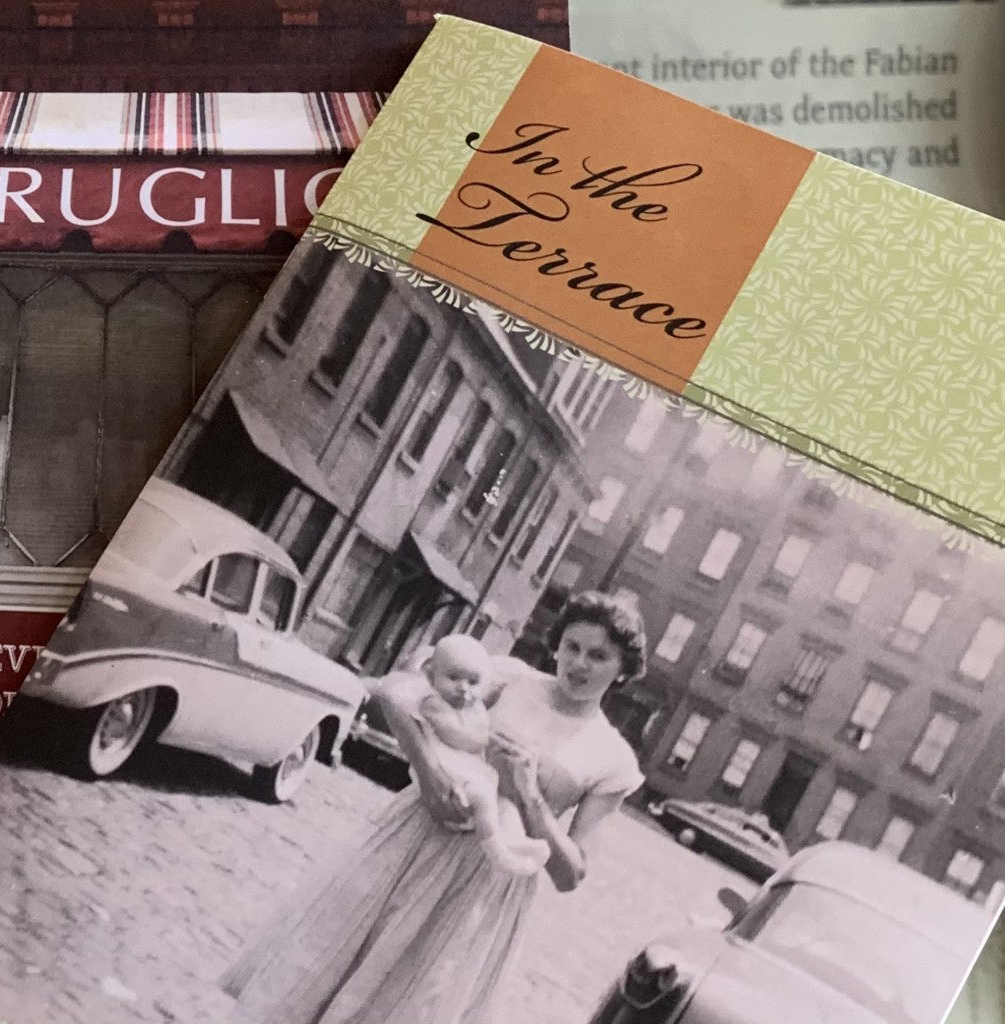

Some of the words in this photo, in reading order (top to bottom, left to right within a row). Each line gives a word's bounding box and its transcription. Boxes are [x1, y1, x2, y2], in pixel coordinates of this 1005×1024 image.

[652, 50, 763, 81] interior
[770, 46, 803, 79] of
[809, 47, 855, 78] the
[865, 44, 958, 77] Fabian
[728, 100, 784, 123] was
[792, 88, 958, 123] demolished
[907, 135, 962, 169] and
[465, 123, 570, 177] In
[571, 156, 704, 222] the
[415, 182, 707, 340] Terrace
